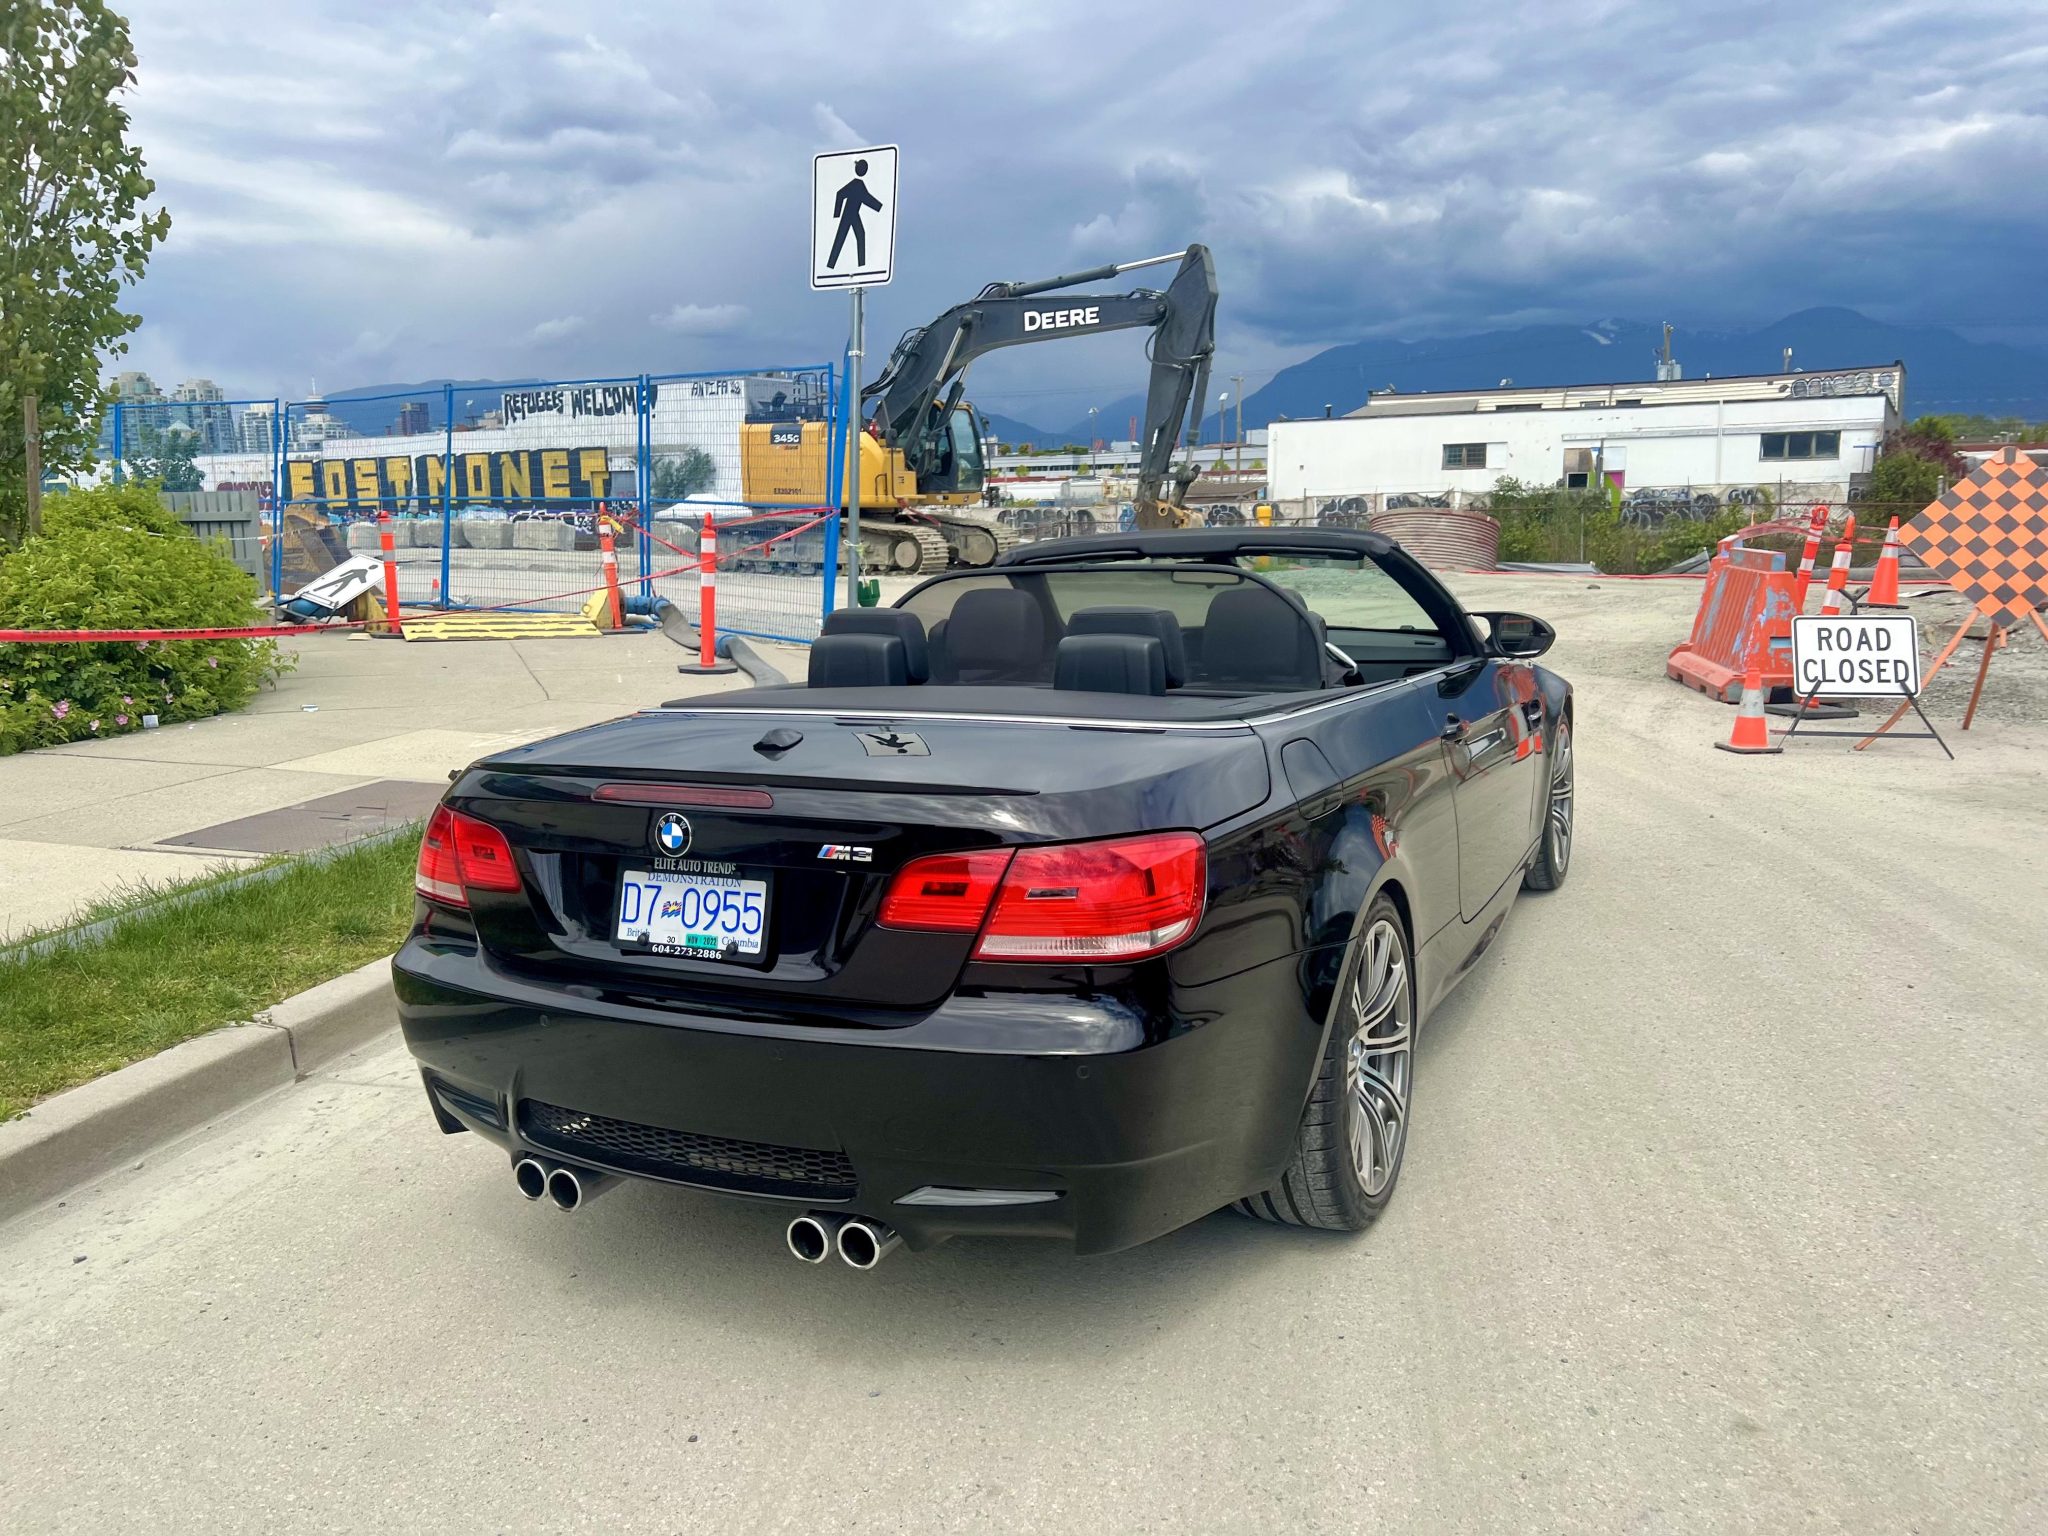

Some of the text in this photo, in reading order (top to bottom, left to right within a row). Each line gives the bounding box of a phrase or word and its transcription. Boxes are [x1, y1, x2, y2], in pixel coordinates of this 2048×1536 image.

[1024, 306, 1100, 331] DEERE
[504, 390, 564, 426] REFUGEES
[773, 433, 800, 443] 345G
[1817, 627, 1892, 652] ROAD
[1803, 658, 1910, 684] CLOSED
[659, 814, 688, 830] BMW
[825, 844, 873, 862] M3
[653, 857, 677, 871] ELITE
[677, 859, 701, 873] AUTO
[647, 872, 742, 888] DEMONSTRATION
[621, 882, 763, 935] D7 0955
[666, 935, 676, 944] 30
[703, 936, 717, 946] 2022
[651, 943, 722, 960] 604-273-2886
